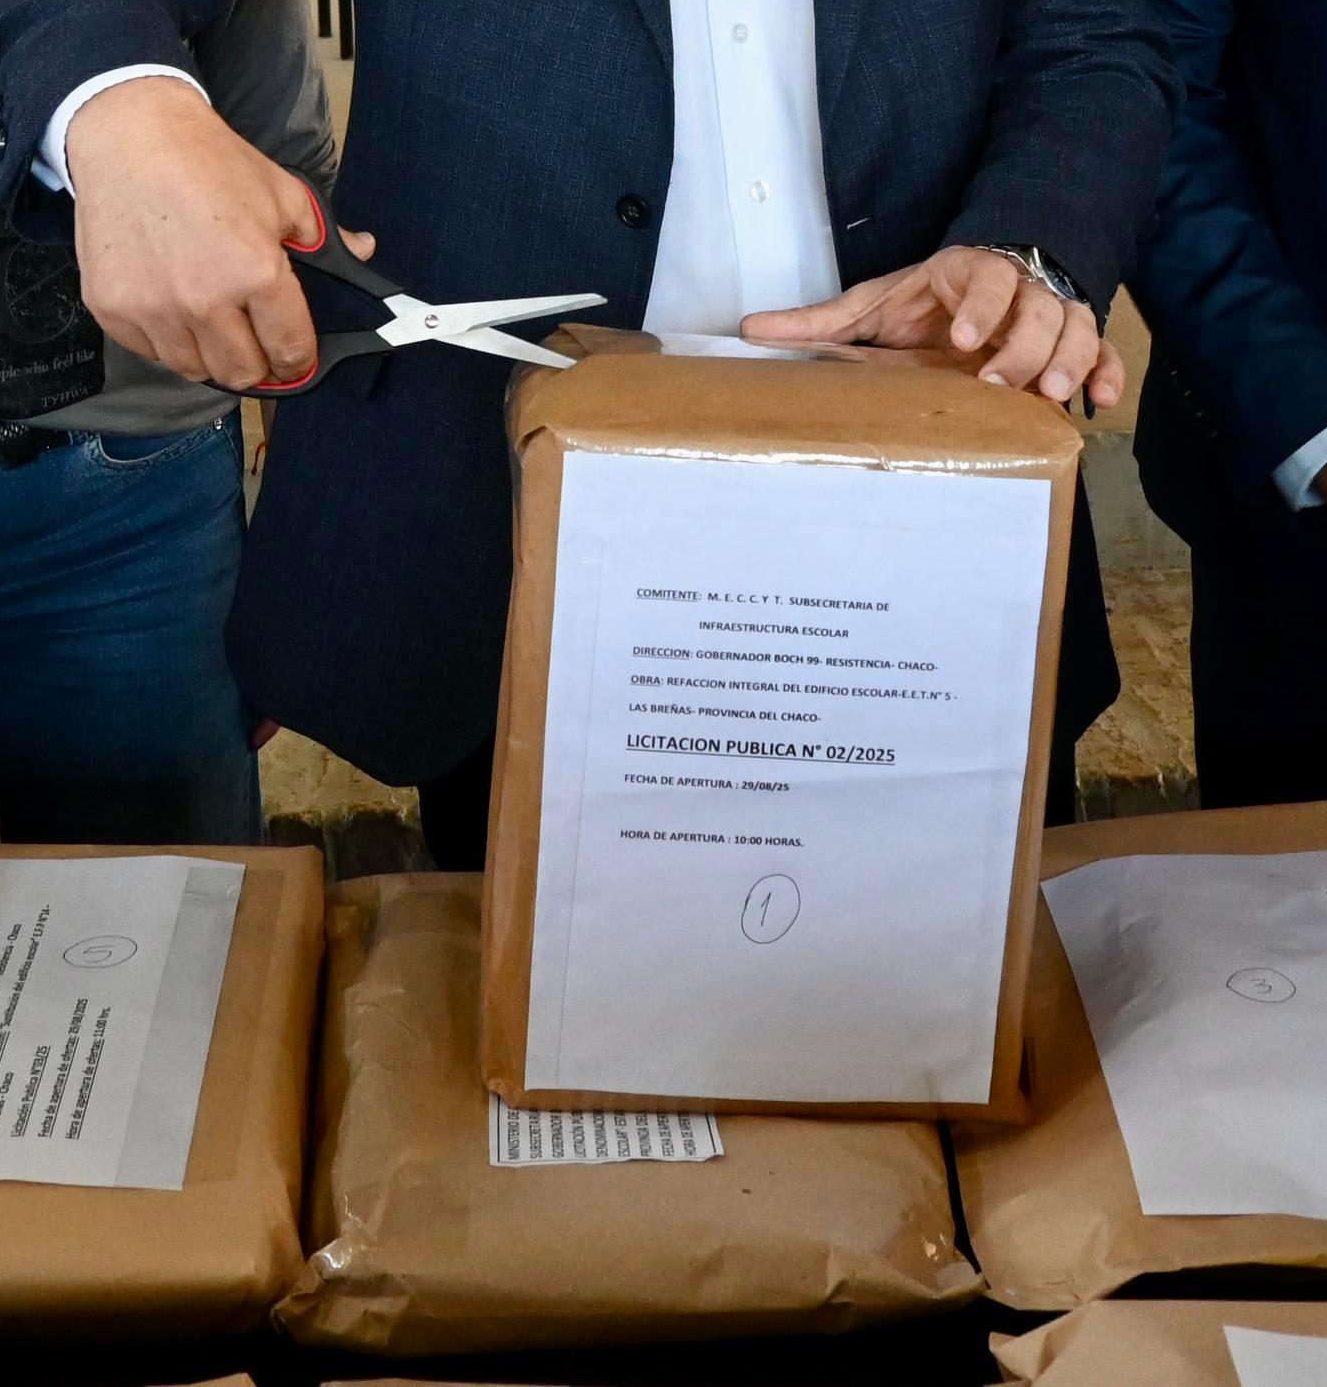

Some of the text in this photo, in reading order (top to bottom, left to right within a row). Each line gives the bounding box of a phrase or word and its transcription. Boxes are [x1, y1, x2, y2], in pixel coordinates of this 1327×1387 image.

[76, 349, 96, 363] like
[636, 588, 701, 602] COMITENTE:
[761, 594, 769, 603] Y
[789, 596, 872, 610] SUBSECRETARIA
[875, 602, 889, 611] DE
[699, 621, 848, 638] INFRAESTRUCTURA ESCOLAR
[632, 646, 692, 660] DIRECCION:
[695, 650, 771, 662] GOBERNADOR
[773, 653, 804, 663] BOCH
[630, 674, 663, 686] OBRA:
[666, 676, 726, 688] REFACCION
[728, 680, 779, 692] INTEGRAL
[782, 682, 801, 693] DEL
[804, 684, 849, 696] EDIFICIO
[944, 691, 951, 701] 5
[628, 702, 647, 712] LAS
[698, 707, 756, 719] PROVINCIA
[758, 710, 777, 720] DEL
[627, 734, 720, 756] LICITACION
[726, 740, 796, 760] PUBLICA
[825, 745, 894, 765] 02/2025
[624, 773, 789, 791] FECHA DE APERTURA 29/08/25
[619, 829, 802, 847] HORA DE APERTURA 10:00 HORAS.
[760, 892, 772, 927] 1
